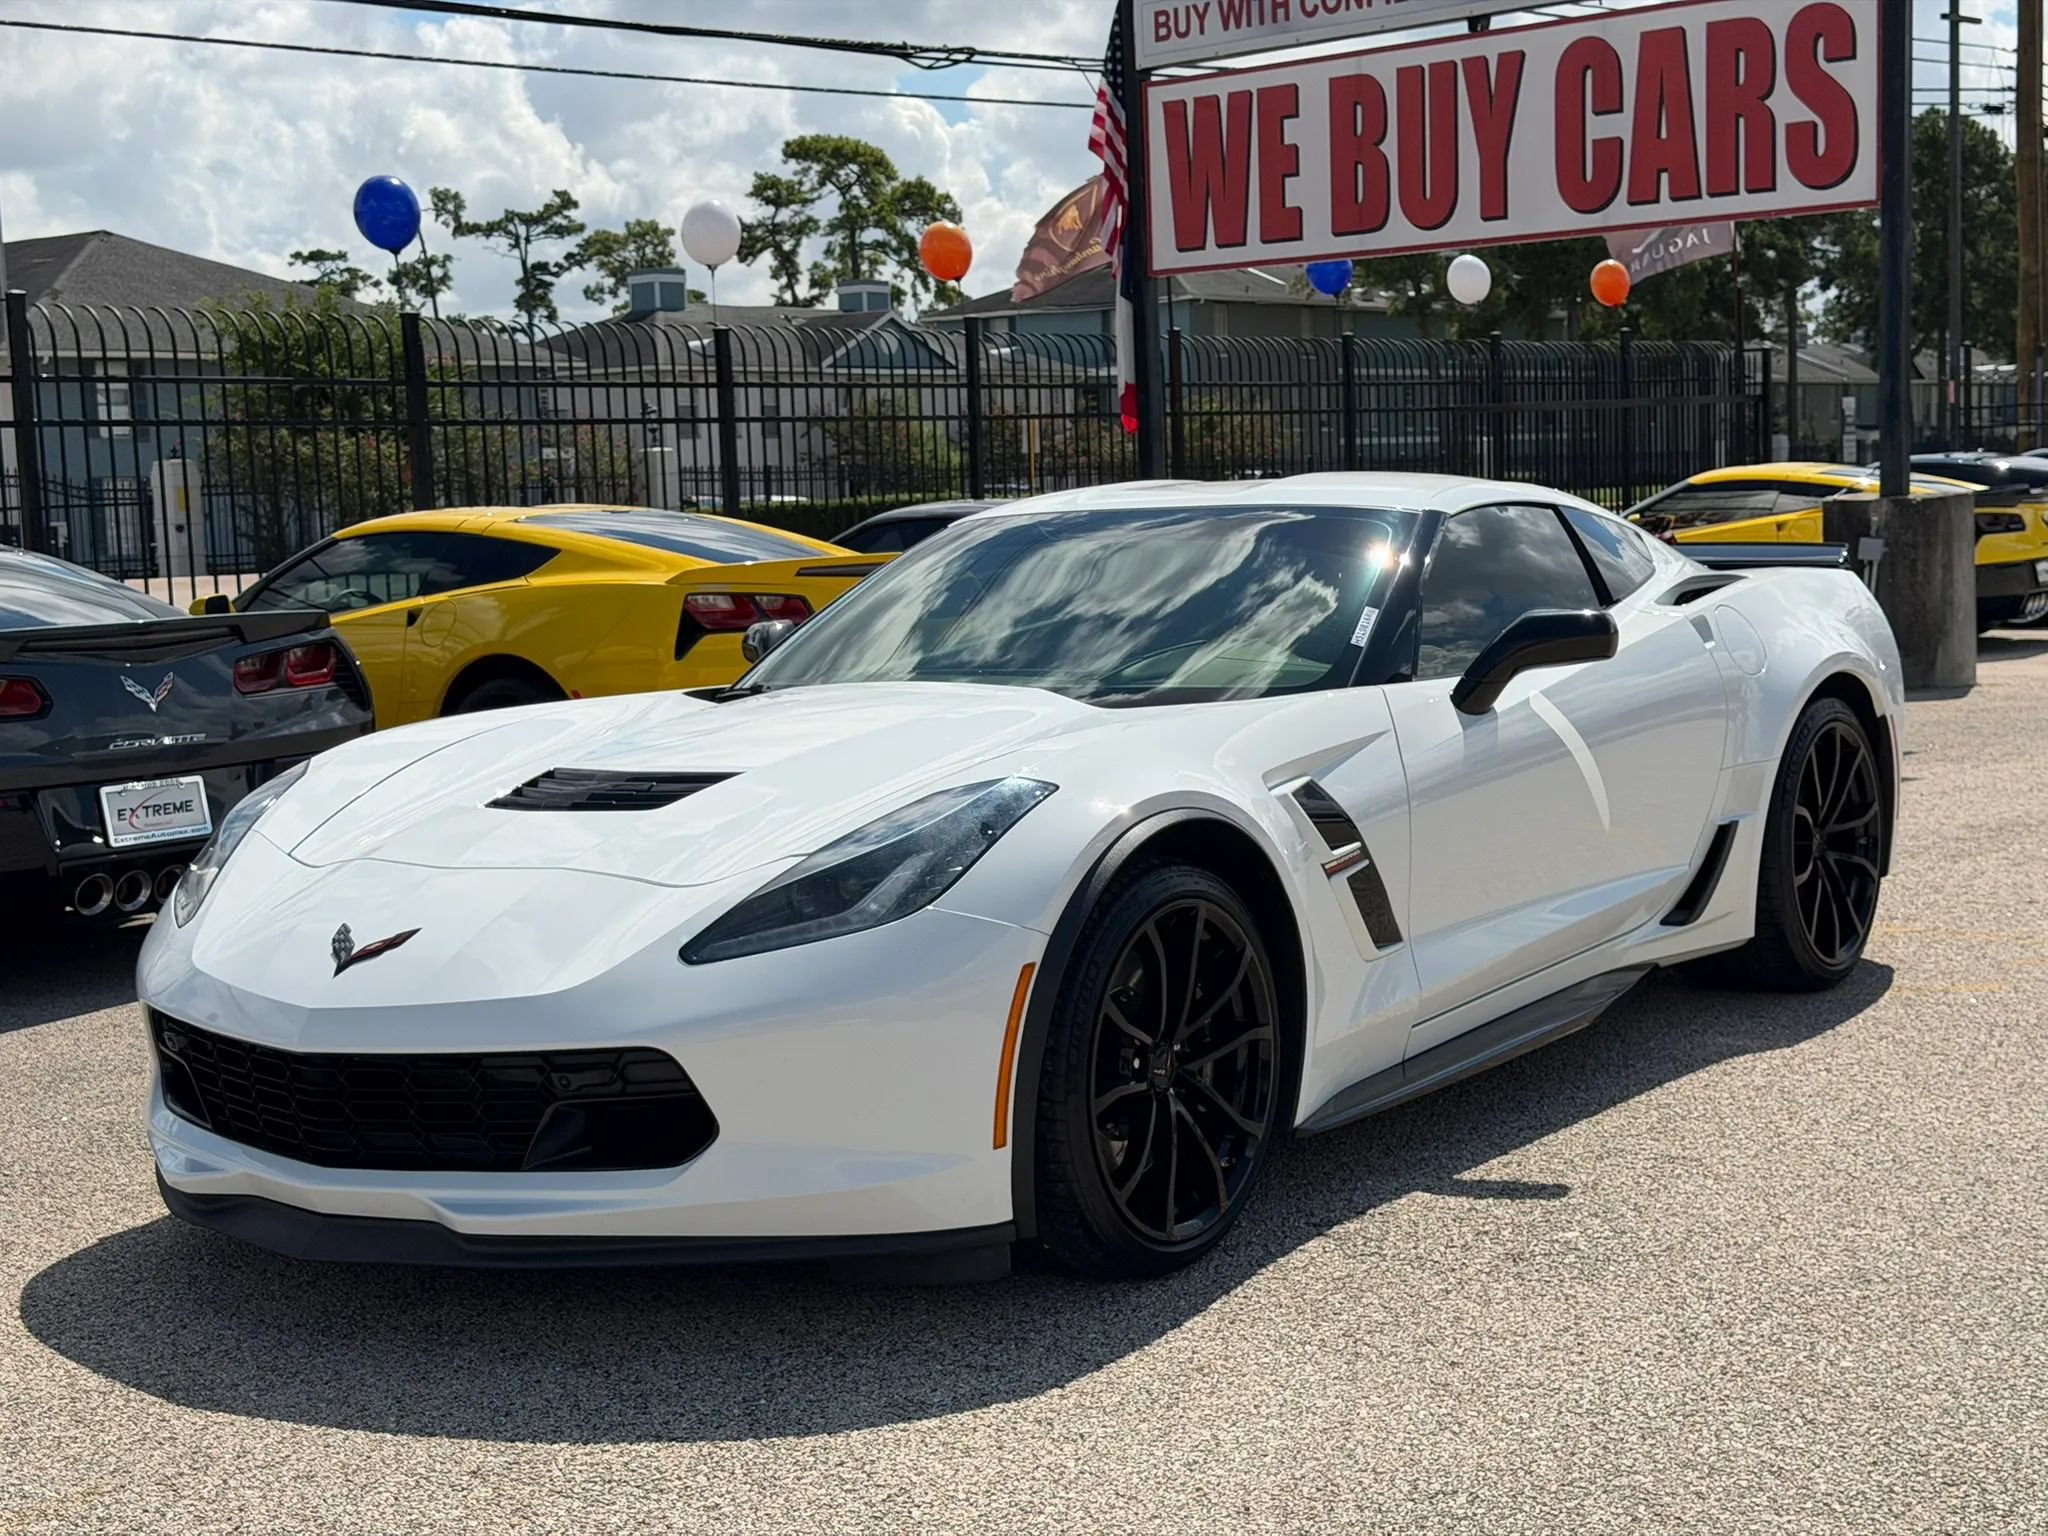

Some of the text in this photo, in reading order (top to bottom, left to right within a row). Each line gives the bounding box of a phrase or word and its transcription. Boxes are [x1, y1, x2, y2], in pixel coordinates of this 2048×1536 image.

[1153, 1, 1211, 43] BUY
[1215, 0, 1291, 32] WITH
[1162, 1, 1858, 252] WE BUY CARS
[117, 799, 195, 821] EXTREME
